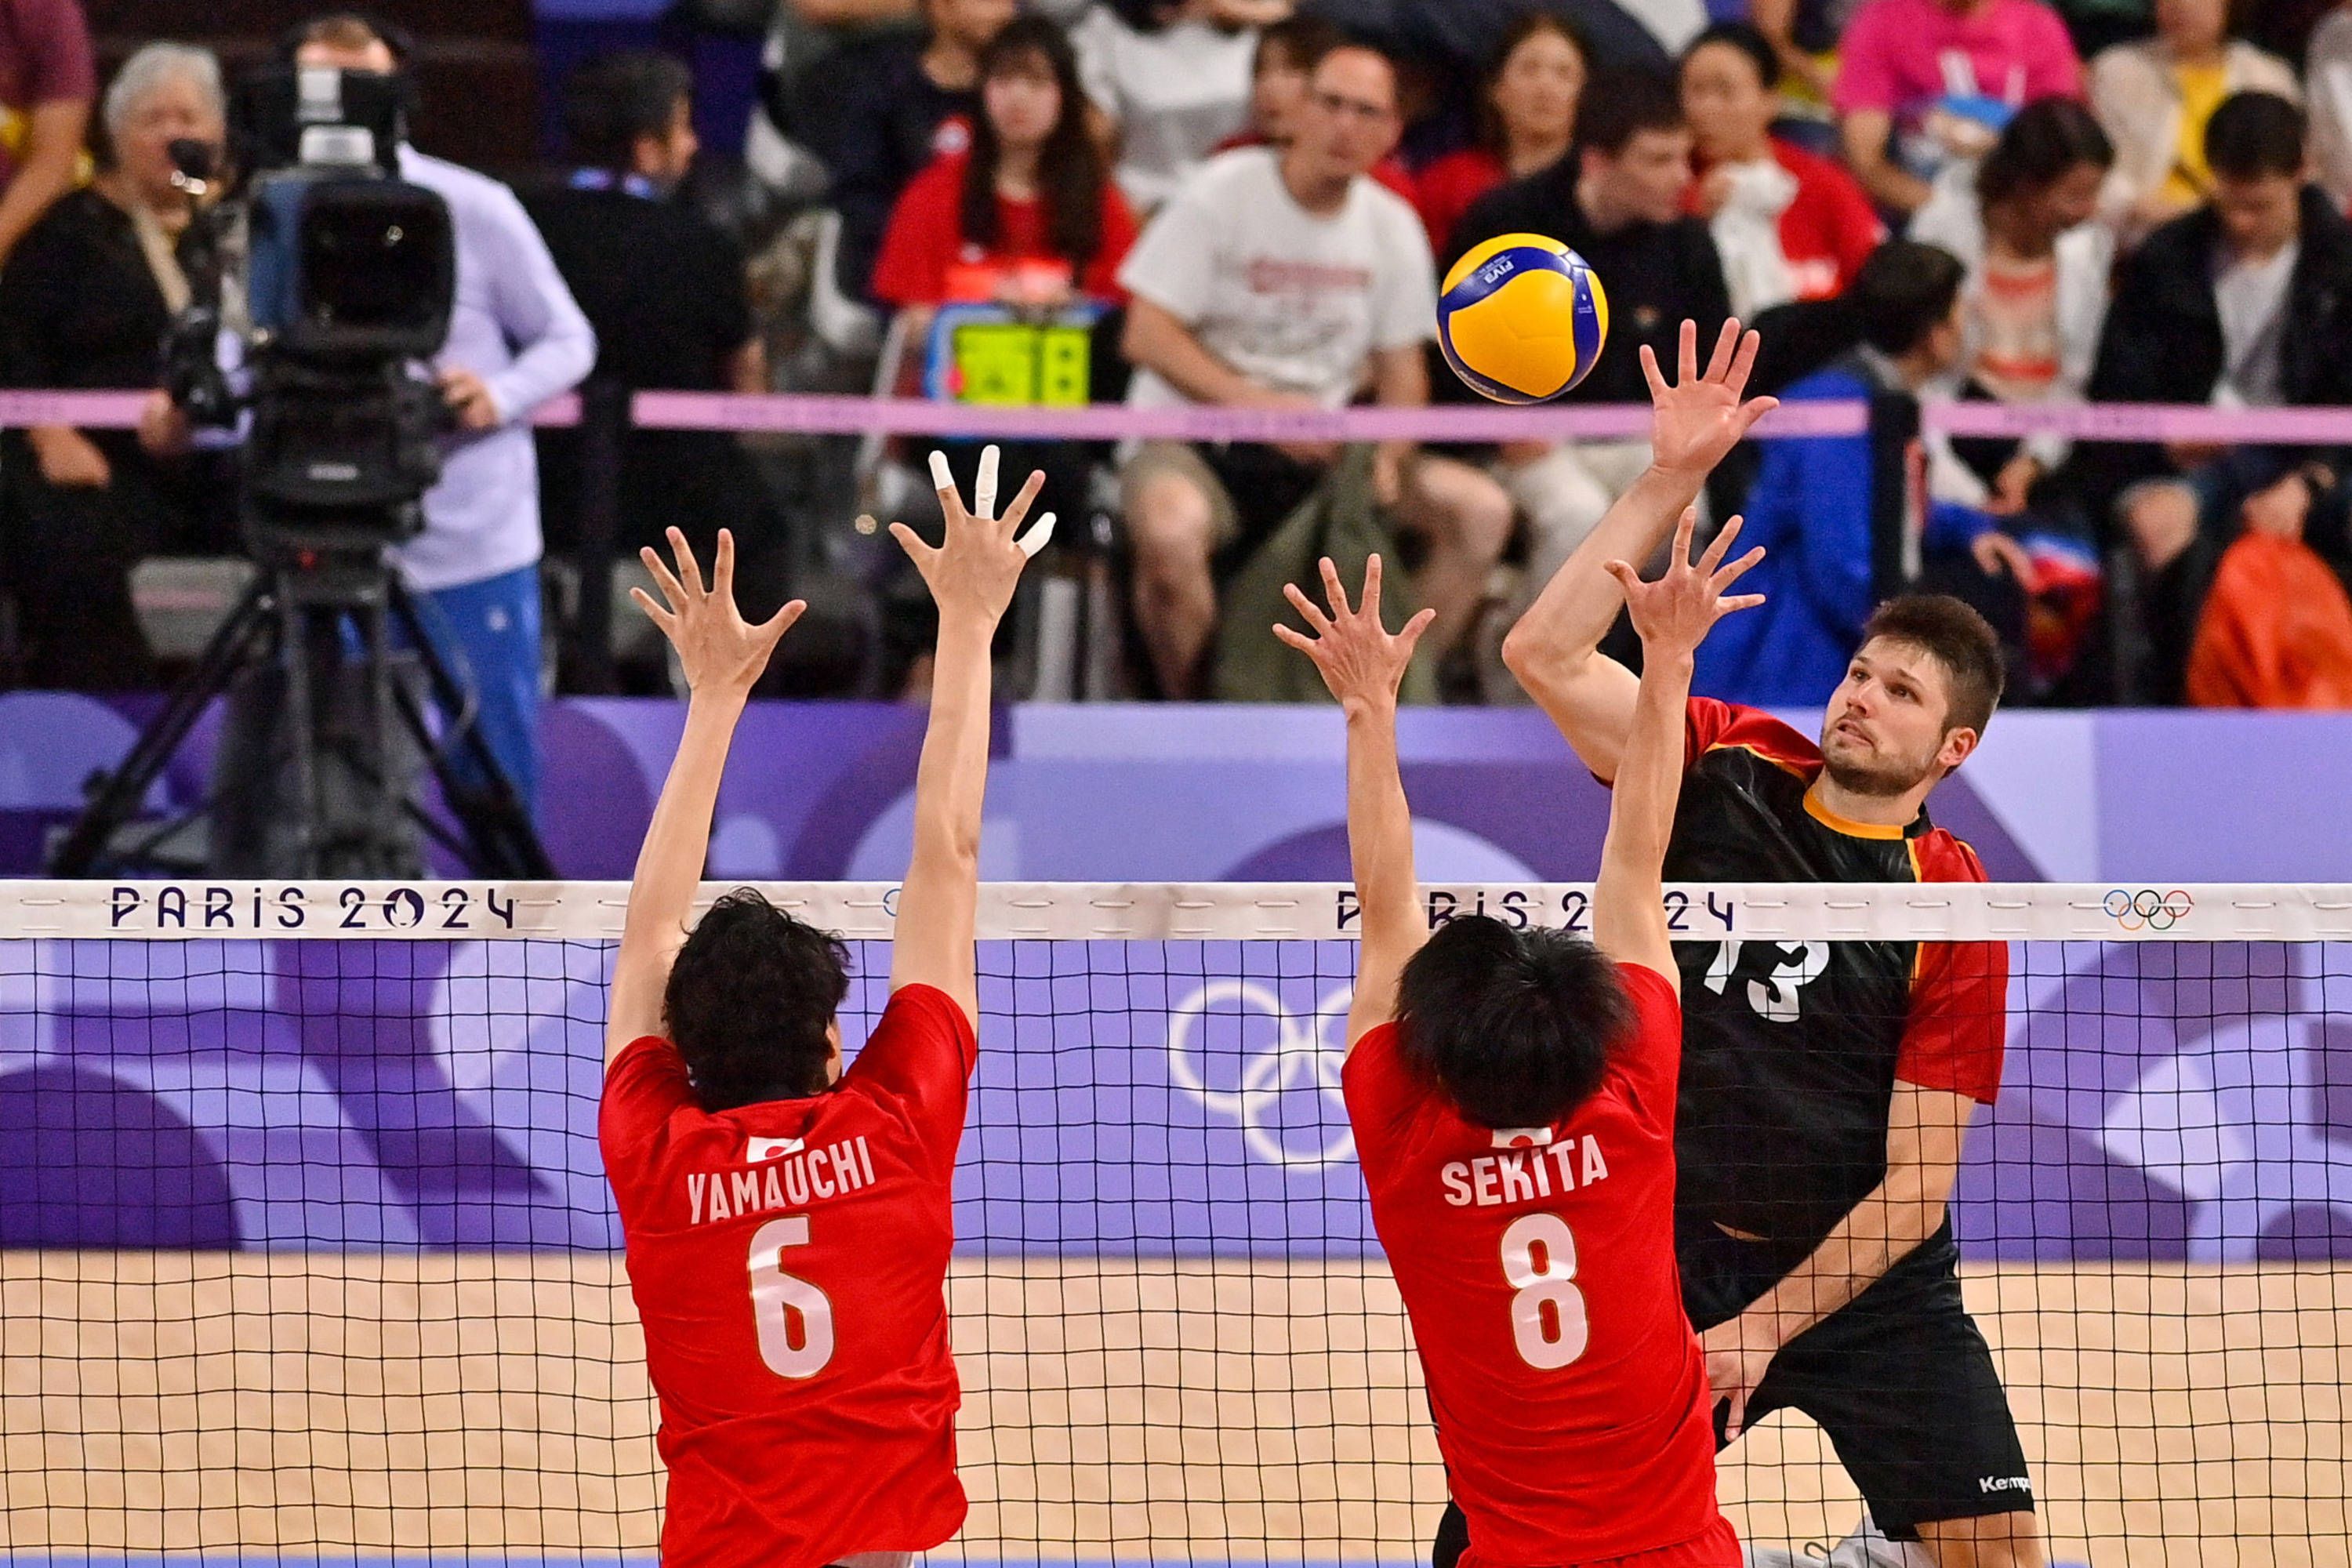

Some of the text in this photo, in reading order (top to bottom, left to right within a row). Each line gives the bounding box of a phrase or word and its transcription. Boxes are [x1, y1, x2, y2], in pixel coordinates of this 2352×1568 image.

[1483, 260, 1515, 285] FIVB
[1562, 891, 1733, 931] 224
[688, 1136, 876, 1224] YAMAUCHI
[1441, 1134, 1609, 1207] SEKITA
[747, 1214, 835, 1379] 6
[1501, 1212, 1590, 1370] 8
[1979, 1475, 2031, 1494] Kemp
